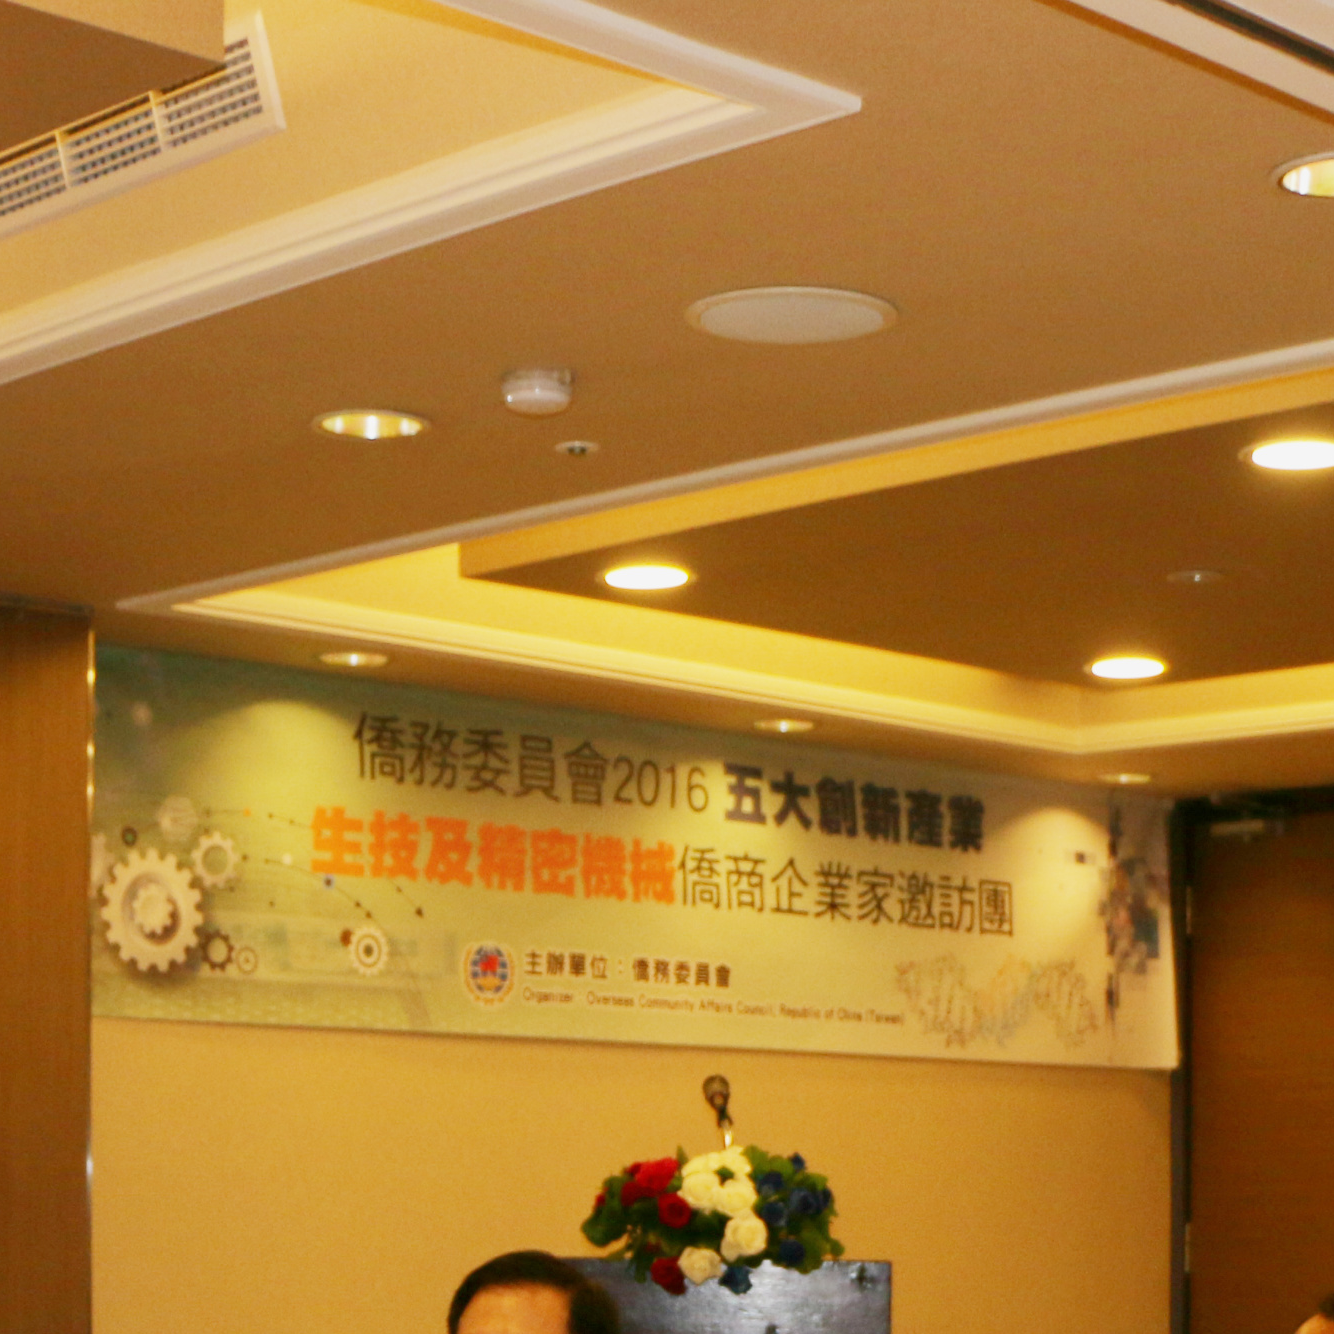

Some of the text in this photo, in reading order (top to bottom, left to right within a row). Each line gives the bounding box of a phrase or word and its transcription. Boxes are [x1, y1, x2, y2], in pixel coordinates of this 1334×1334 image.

[353, 713, 985, 853] 僑務委員會2016 五大創新產業
